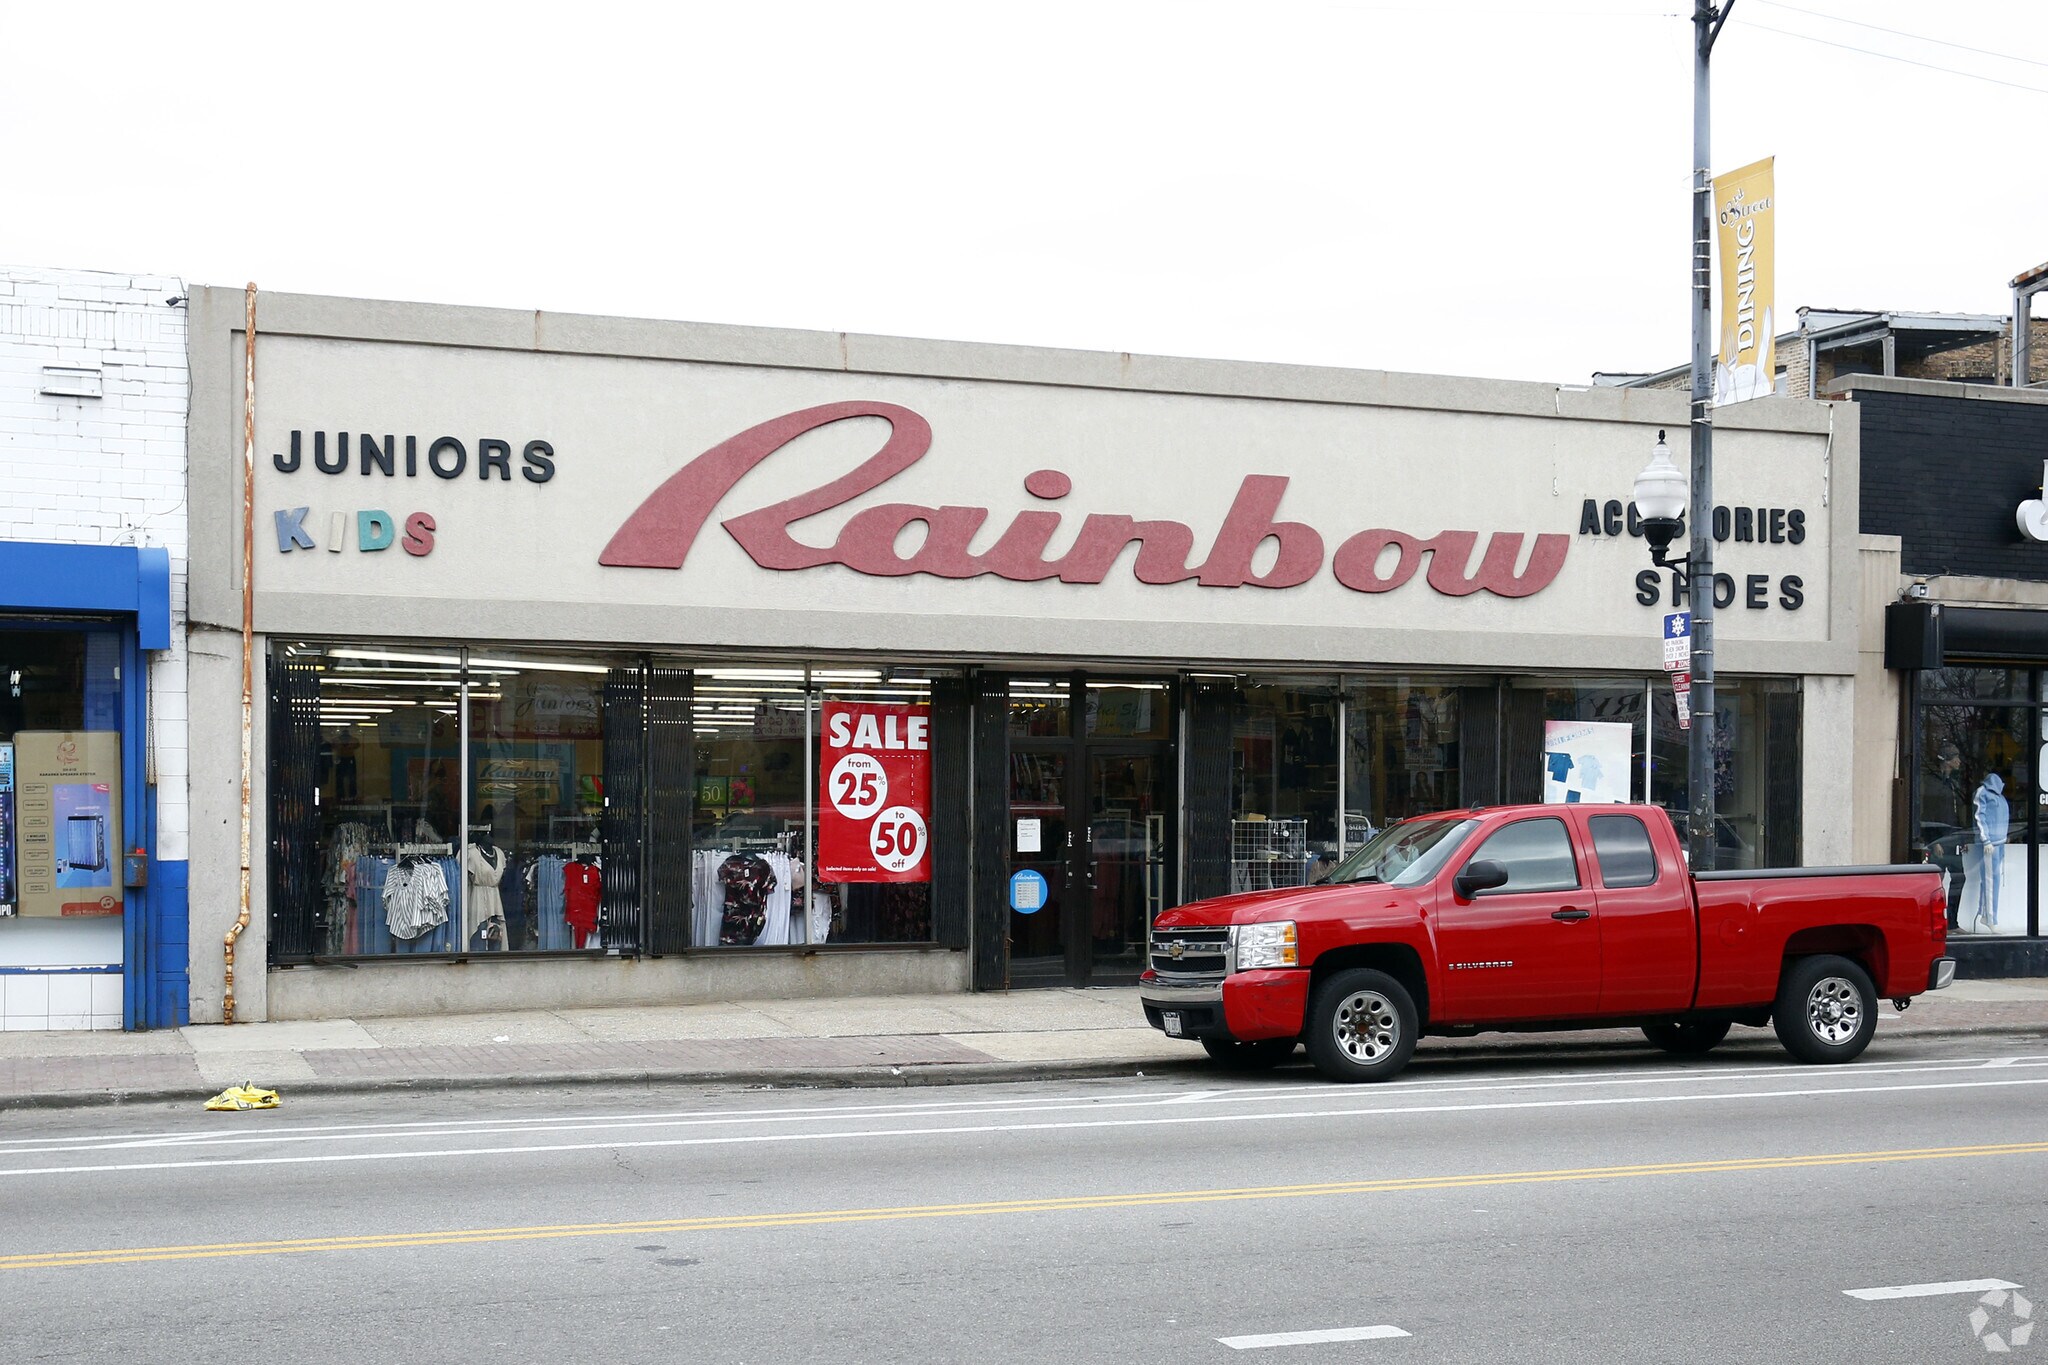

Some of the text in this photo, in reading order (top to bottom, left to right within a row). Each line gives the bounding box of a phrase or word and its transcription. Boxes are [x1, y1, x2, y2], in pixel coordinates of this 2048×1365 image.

[1736, 219, 1755, 353] DINING
[274, 430, 555, 483] JUNIORS
[598, 400, 1570, 599] Rainbow
[274, 507, 437, 557] KIDS
[1579, 499, 1806, 545] ACCORIES
[830, 712, 928, 750] SALE
[479, 761, 555, 779] Rainbow
[848, 758, 871, 768] from
[702, 785, 721, 802] 50
[895, 811, 905, 819] to
[891, 859, 905, 868] off
[1456, 961, 1513, 970] SILVERADO
